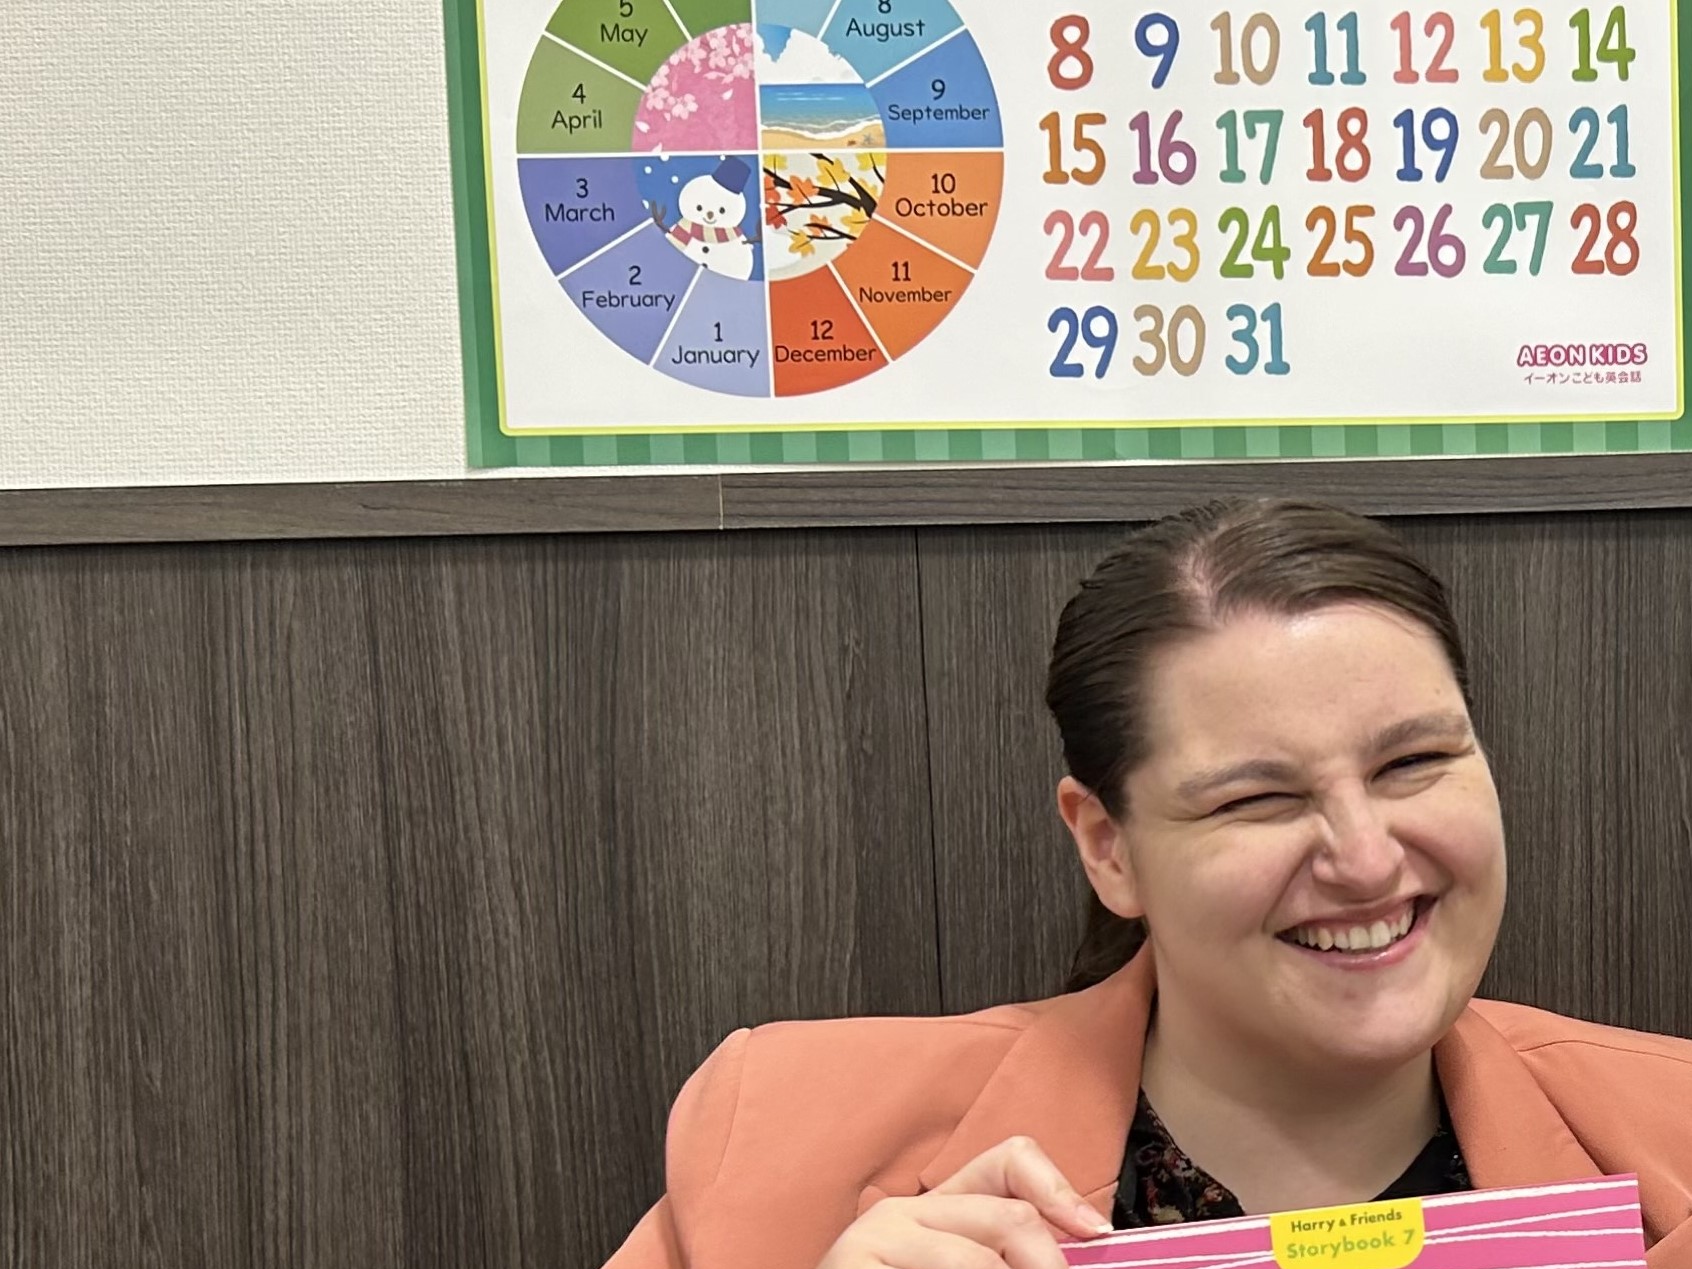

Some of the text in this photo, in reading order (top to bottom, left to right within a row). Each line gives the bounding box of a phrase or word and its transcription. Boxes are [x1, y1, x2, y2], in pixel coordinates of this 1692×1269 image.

[619, 0, 633, 19] 5
[600, 24, 648, 46] May
[845, 18, 926, 38] August
[1047, 6, 1636, 91] 8 9 10 11 12 13 14
[571, 83, 586, 104] 4
[931, 79, 946, 100] 9
[551, 109, 603, 131] April
[887, 103, 991, 124] September
[1038, 104, 1637, 185] 15 16 17 18 19 20 21
[576, 178, 589, 199] 3
[931, 173, 956, 195] 10
[545, 203, 616, 224] March
[894, 197, 989, 219] October
[1043, 200, 1640, 282] 22 23 24 25 26 27 28
[629, 265, 641, 286] 2
[891, 261, 911, 282] 11
[581, 290, 676, 311] February
[859, 285, 952, 304] November
[714, 322, 724, 343] 1
[809, 321, 834, 341] 12
[1047, 303, 1291, 379] 29 30 31
[671, 346, 760, 368] January
[774, 344, 877, 365] December
[1517, 343, 1648, 367] AEON KIDS
[1524, 370, 1642, 385] イーオンこども英会話
[1290, 1219, 1335, 1233] Harry
[1350, 1208, 1402, 1226] Friends
[1286, 1229, 1415, 1259] Storybook 7
